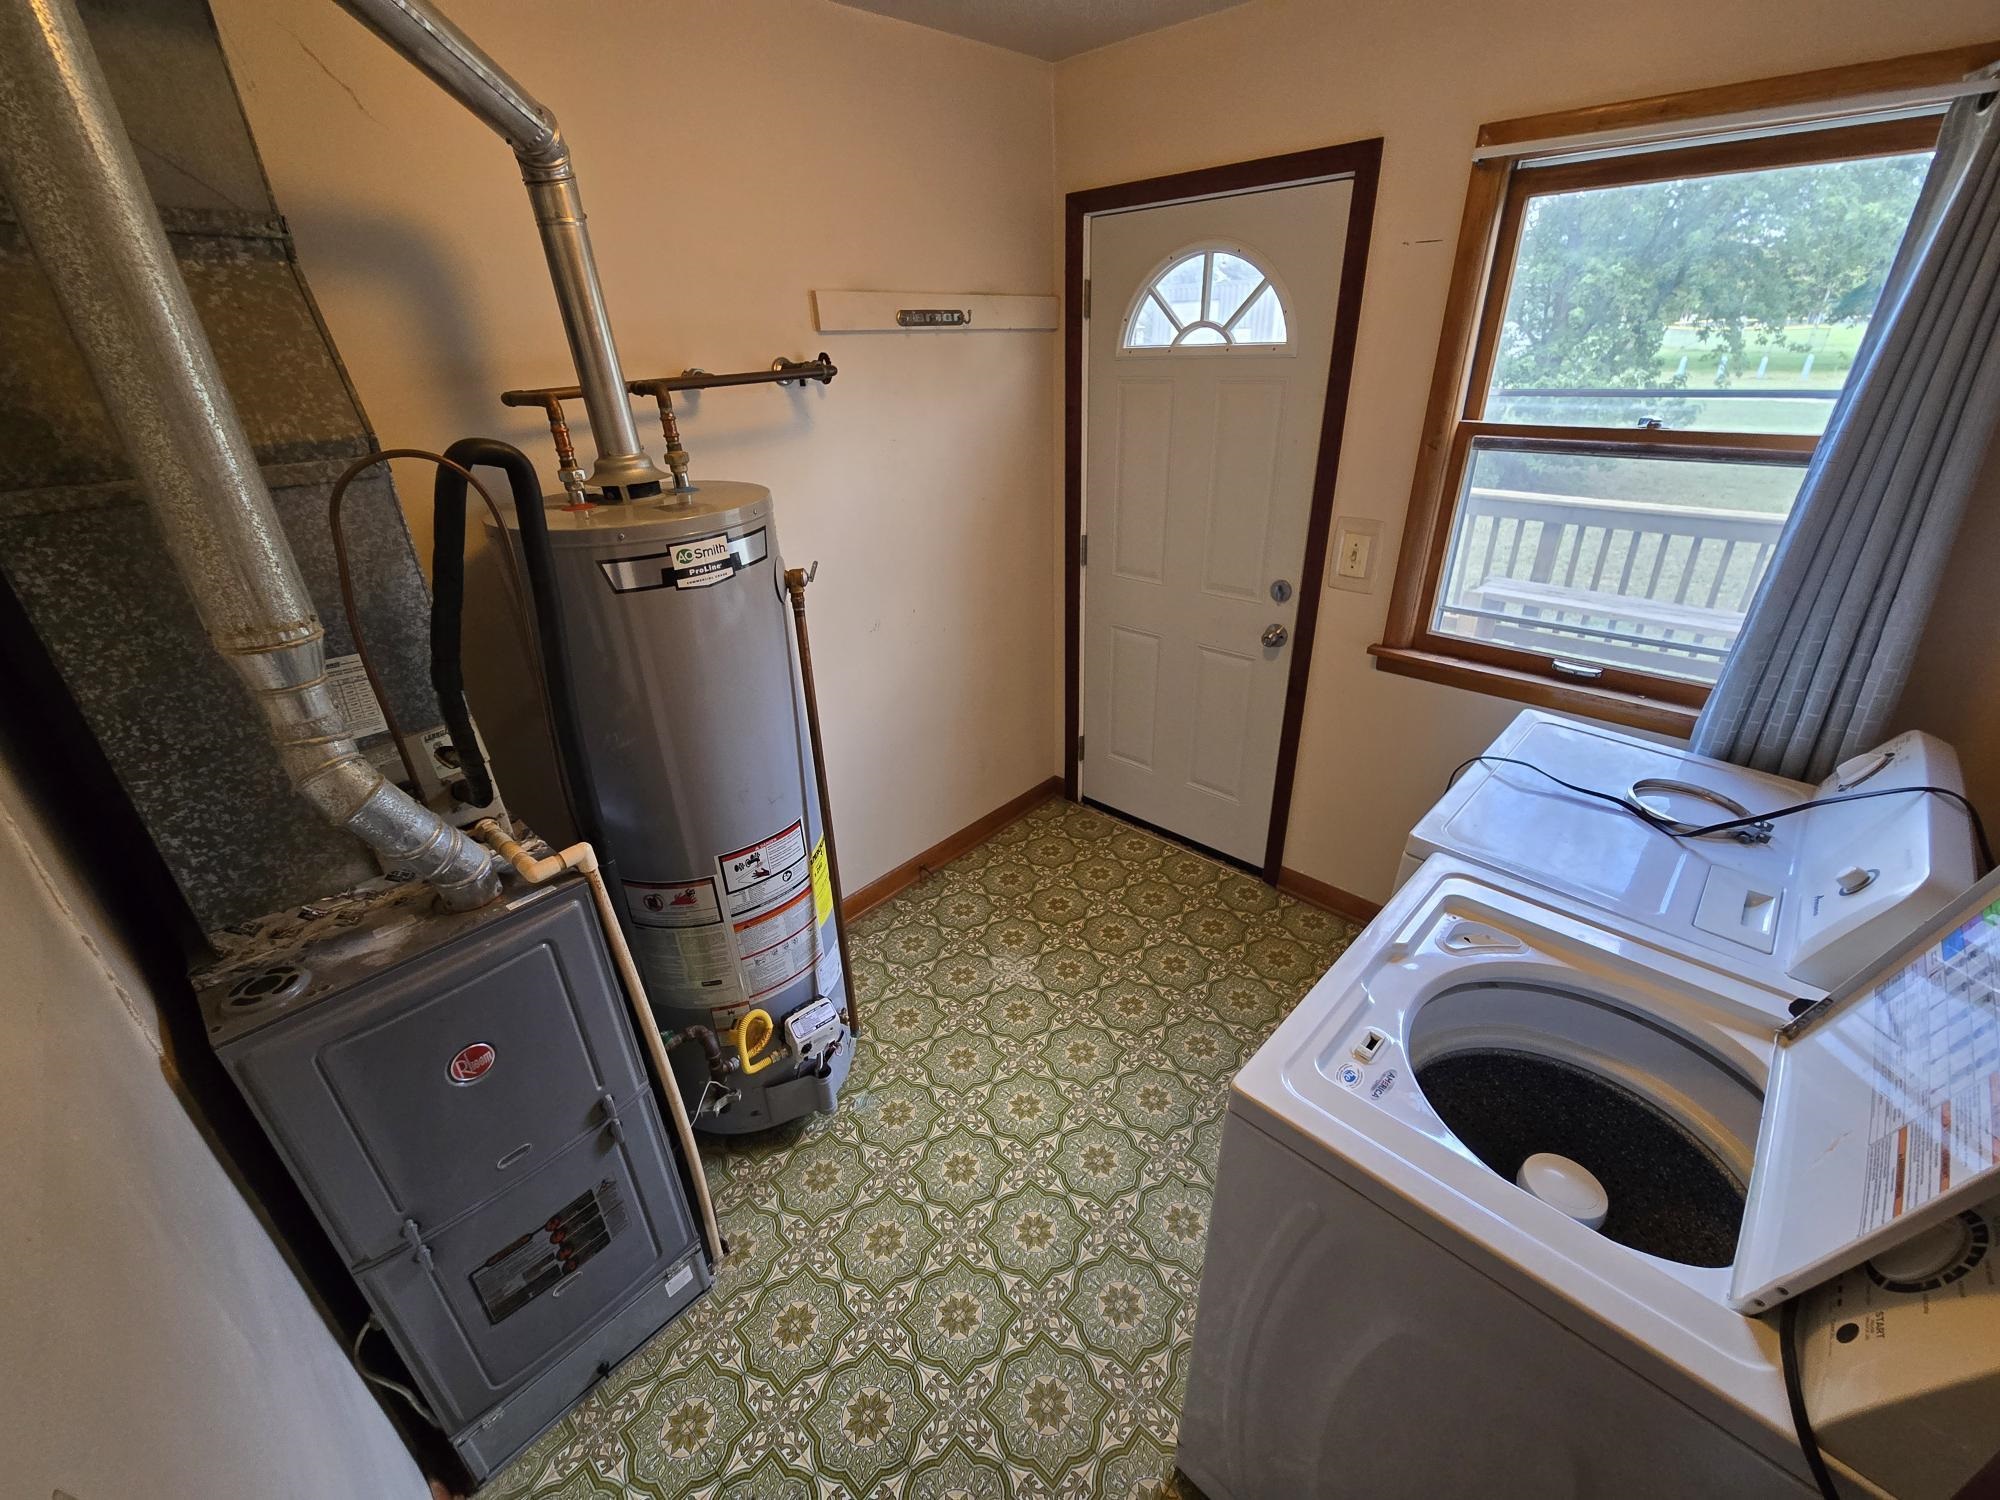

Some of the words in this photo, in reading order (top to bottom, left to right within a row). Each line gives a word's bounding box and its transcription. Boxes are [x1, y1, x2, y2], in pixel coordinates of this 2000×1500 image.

[694, 544, 727, 559] Smith
[689, 564, 722, 576] ProLine
[455, 1051, 493, 1079] Rheem
[1371, 1072, 1396, 1099] AMERICA
[1875, 1311, 1885, 1338] START
